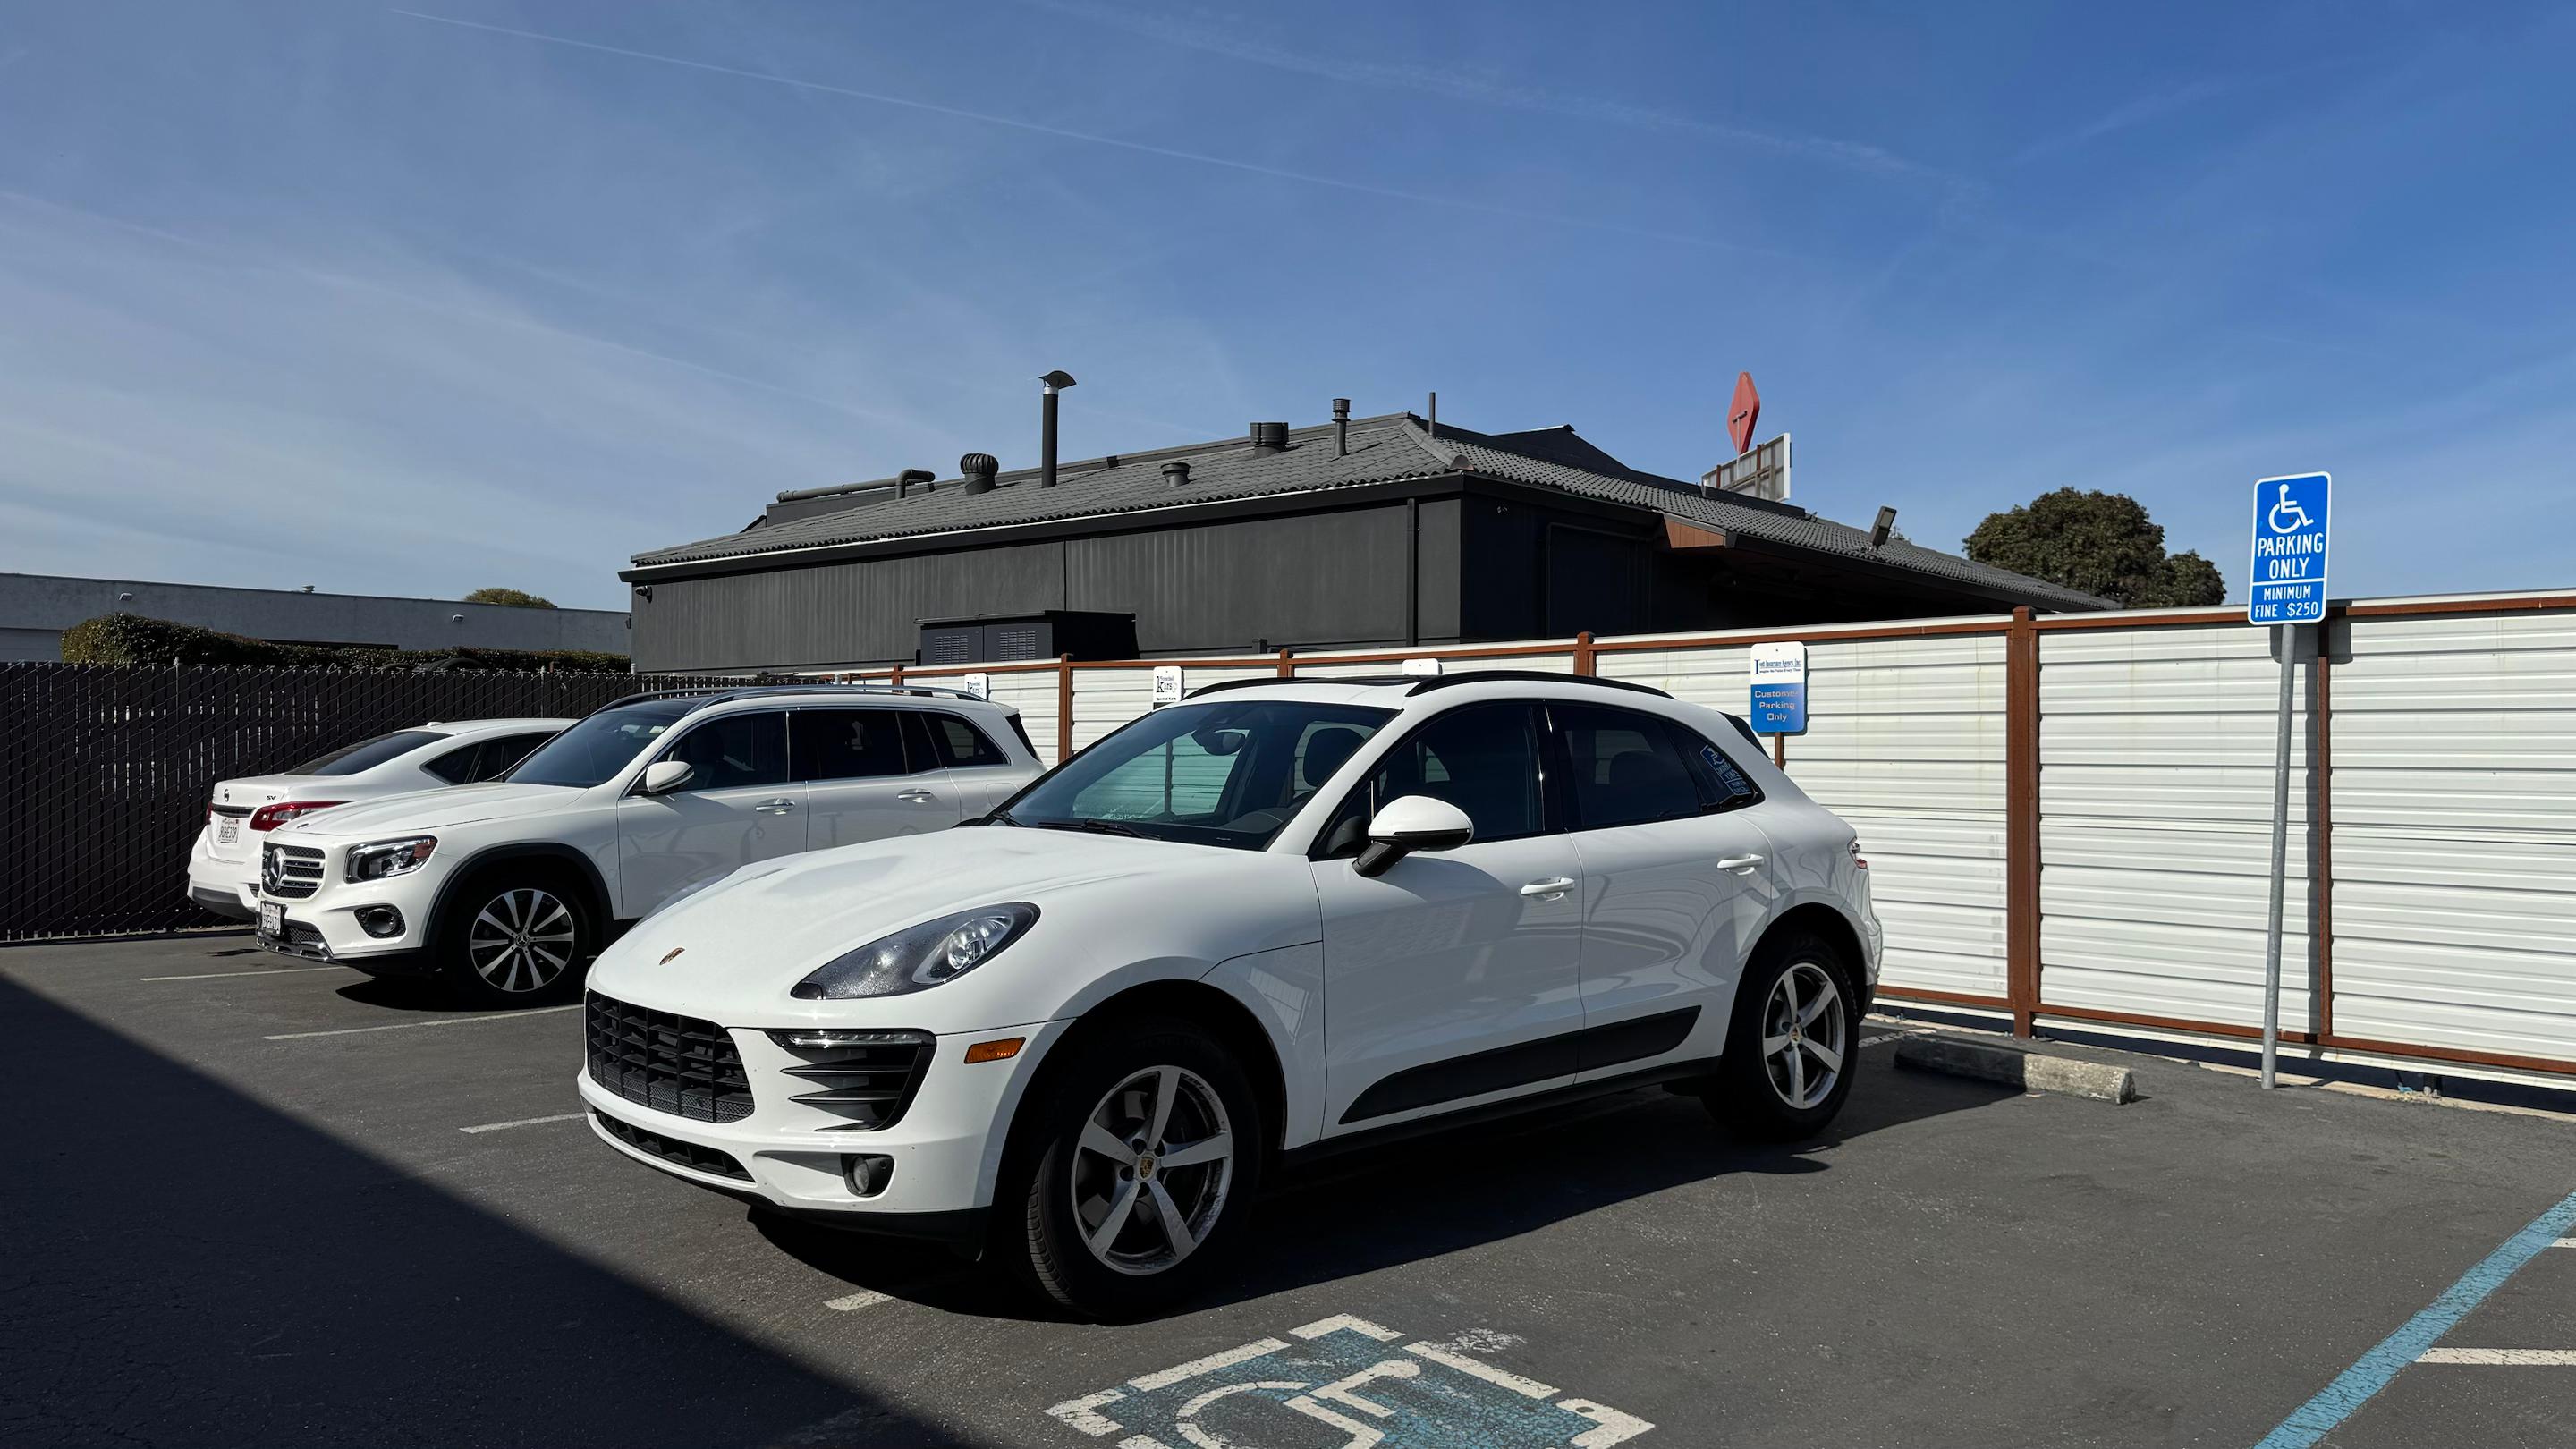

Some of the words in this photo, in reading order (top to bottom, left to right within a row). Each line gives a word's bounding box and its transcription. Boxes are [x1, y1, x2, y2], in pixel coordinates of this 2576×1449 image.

[2258, 532, 2324, 557] PARKING
[2268, 557, 2310, 580] ONLY
[2263, 585, 2311, 601] MINIMUM
[2254, 603, 2278, 618] FINE
[2286, 601, 2318, 618] $250
[1759, 701, 1795, 710] Parking
[1767, 713, 1787, 722] Only
